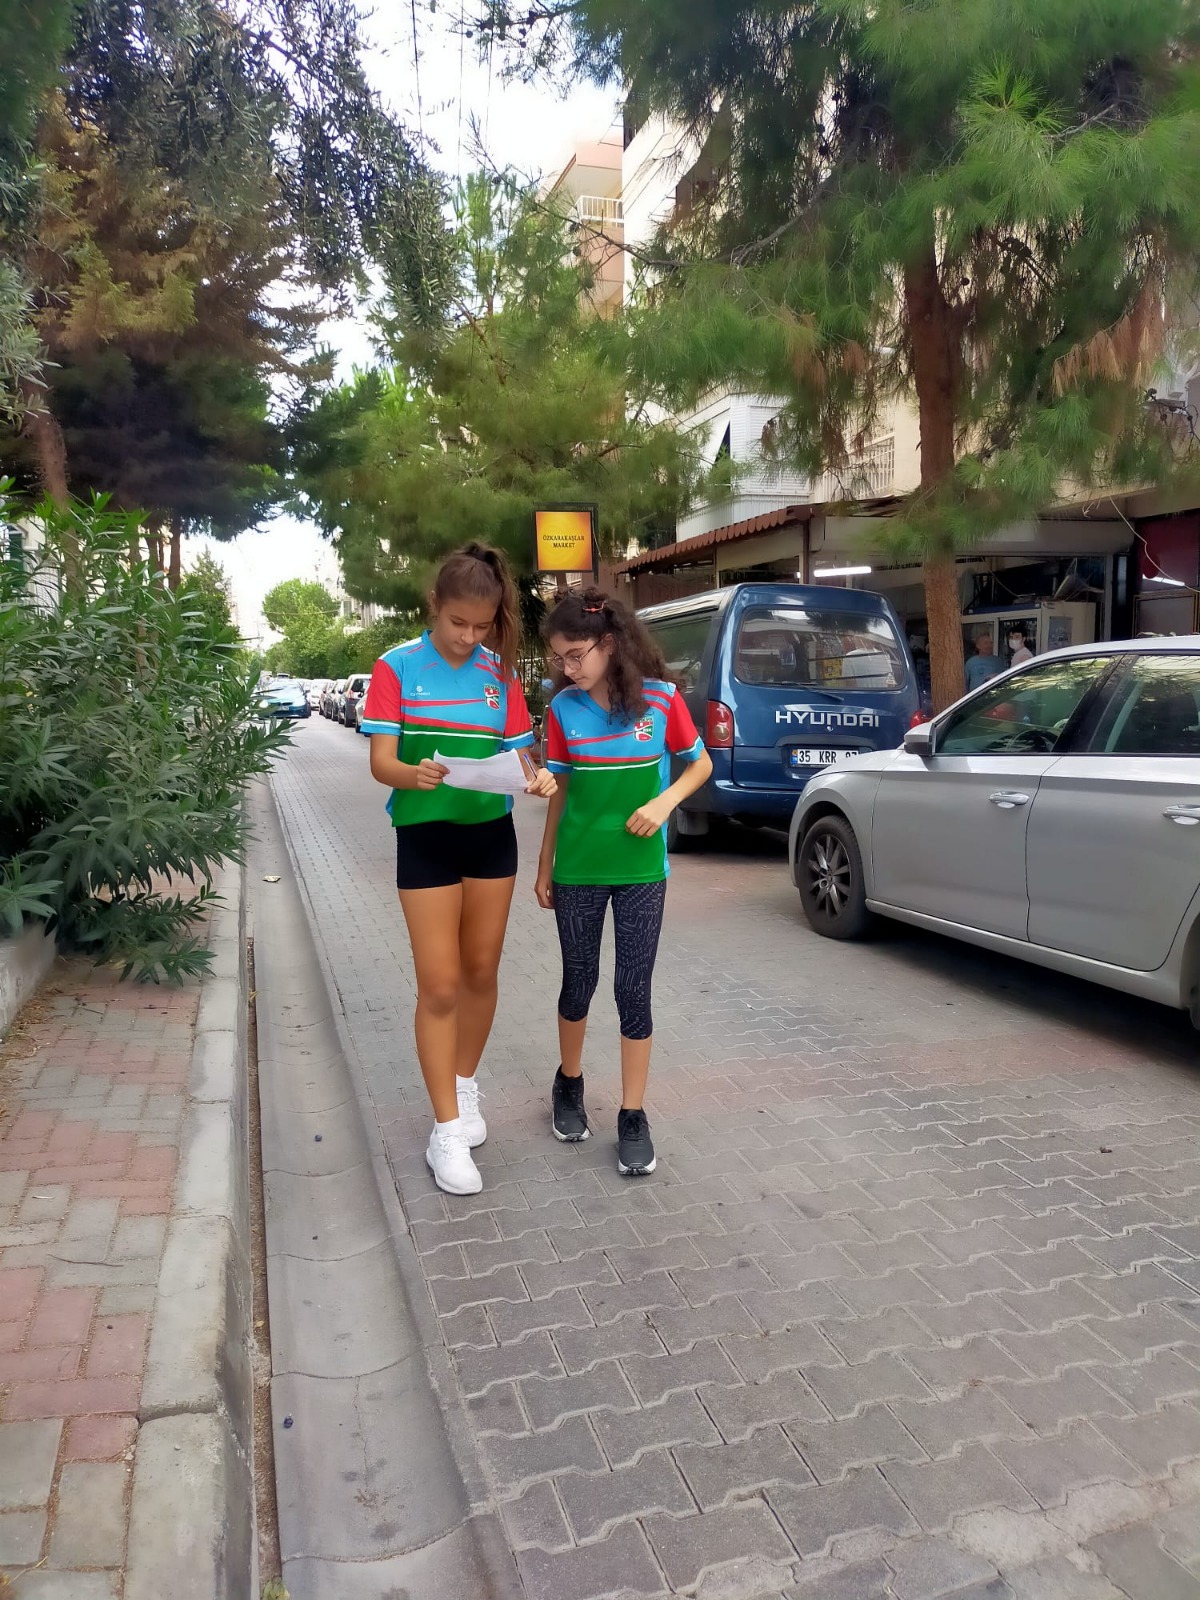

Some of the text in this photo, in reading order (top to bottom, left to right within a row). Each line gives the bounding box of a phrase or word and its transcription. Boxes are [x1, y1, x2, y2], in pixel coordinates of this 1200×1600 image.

[775, 710, 879, 727] HYUNDAI
[799, 750, 811, 763] 35
[819, 750, 837, 764] KRR
